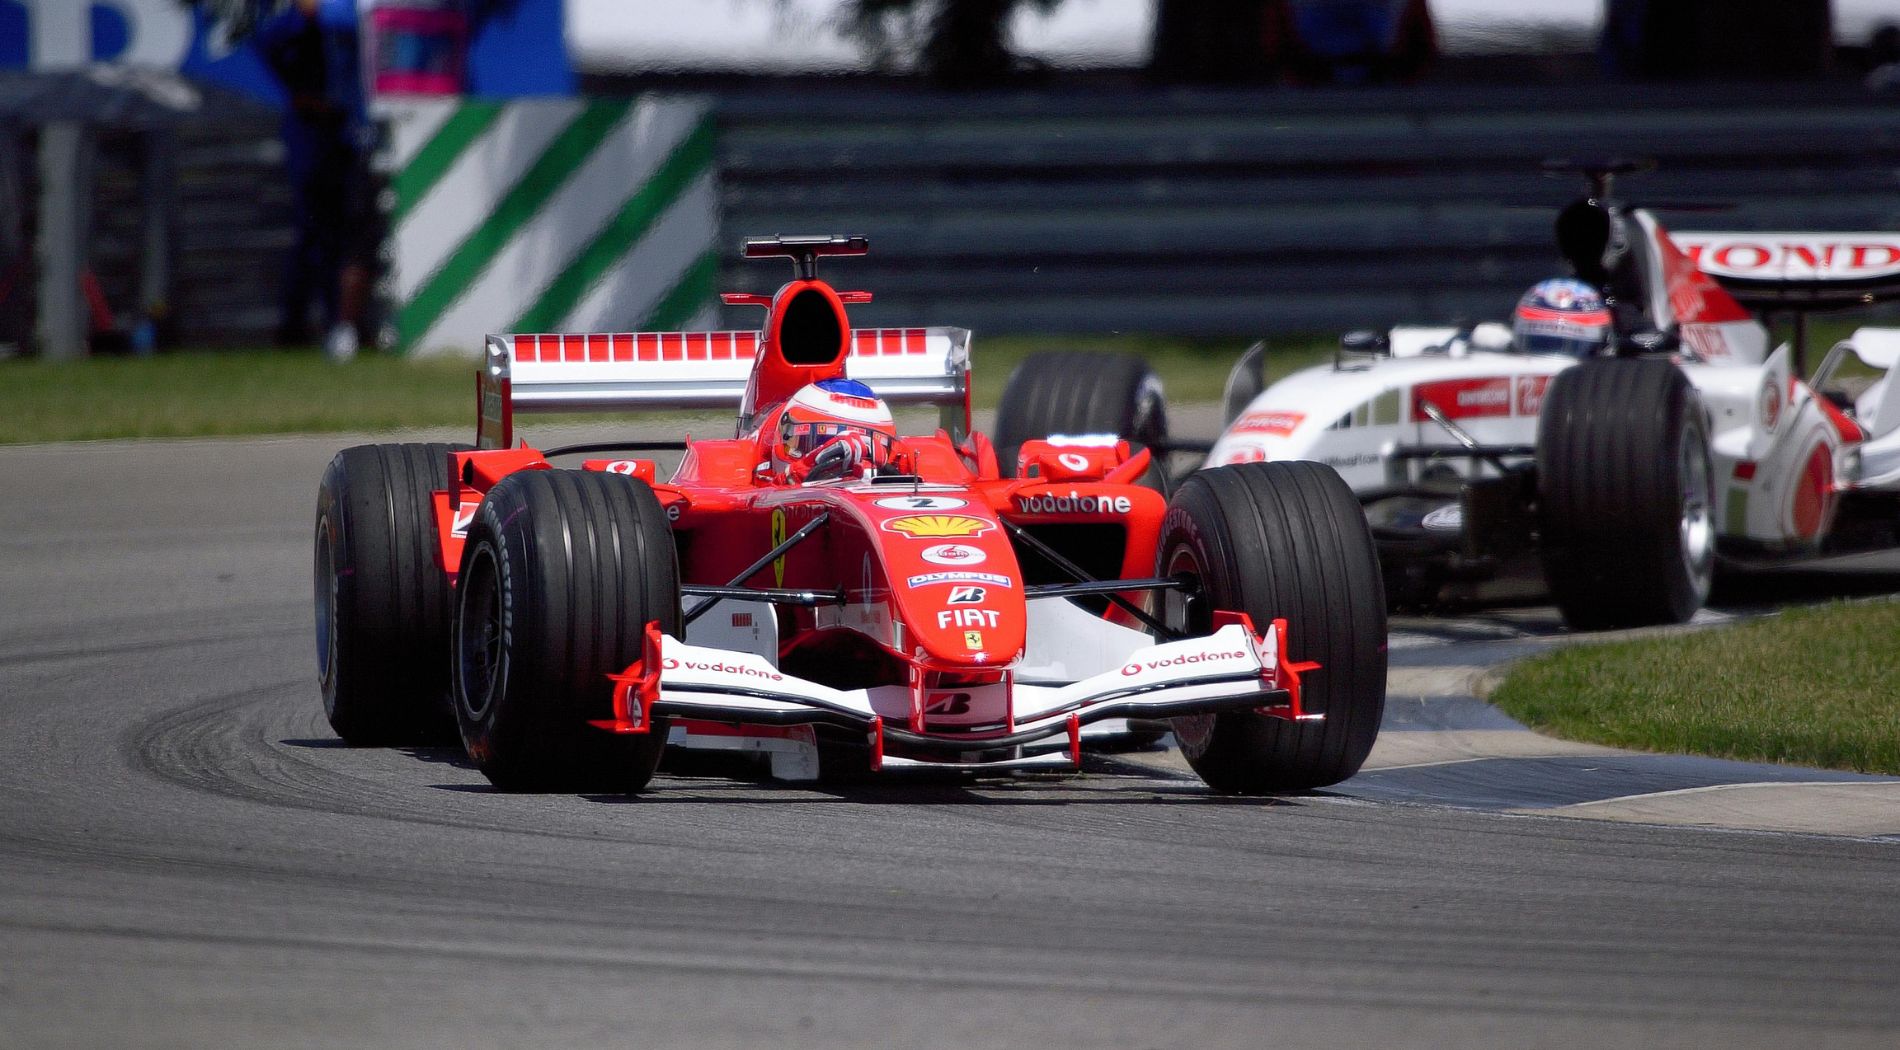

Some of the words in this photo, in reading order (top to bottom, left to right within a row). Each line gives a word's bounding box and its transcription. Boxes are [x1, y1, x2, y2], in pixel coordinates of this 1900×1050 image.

[906, 498, 939, 509] 2
[1019, 490, 1132, 514] vodafone
[911, 572, 1008, 585] OLYMPUS
[937, 608, 1000, 630] FIAT
[1147, 650, 1246, 670] vodafone
[684, 661, 784, 682] vodafone
